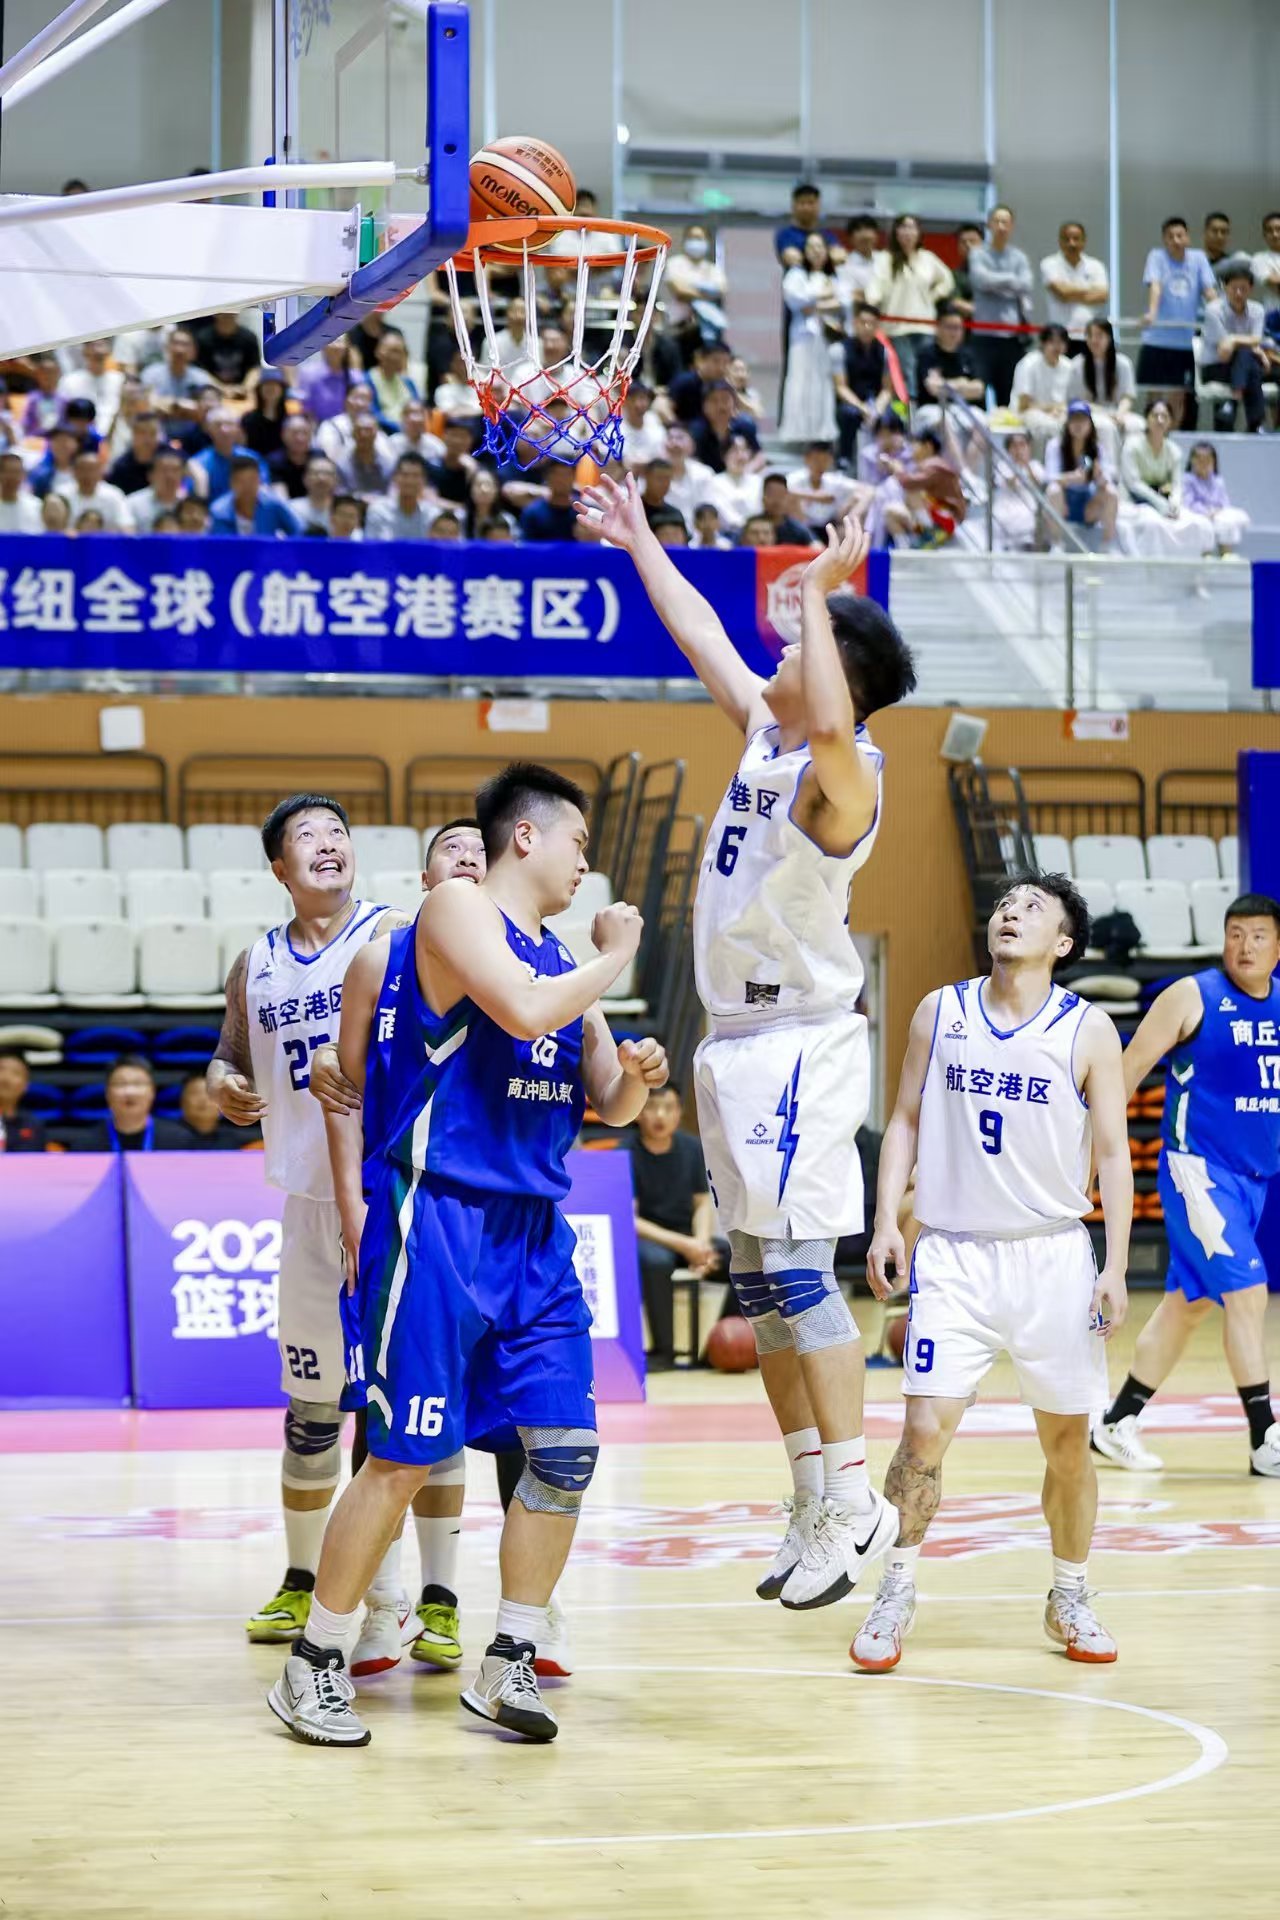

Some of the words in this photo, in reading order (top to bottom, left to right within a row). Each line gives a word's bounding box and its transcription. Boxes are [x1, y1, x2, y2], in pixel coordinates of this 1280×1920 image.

[480, 175, 539, 216] molten
[0, 565, 620, 643] 纽全球(航空港赛区)
[708, 825, 748, 878] 6
[258, 983, 343, 1034] 航空港区
[1229, 1019, 1280, 1047] 商丘
[945, 1064, 1052, 1104] 航空港区
[979, 1109, 1004, 1155] 9
[286, 1345, 321, 1380] 22
[915, 1338, 935, 1373] 9
[404, 1395, 446, 1437] 16
